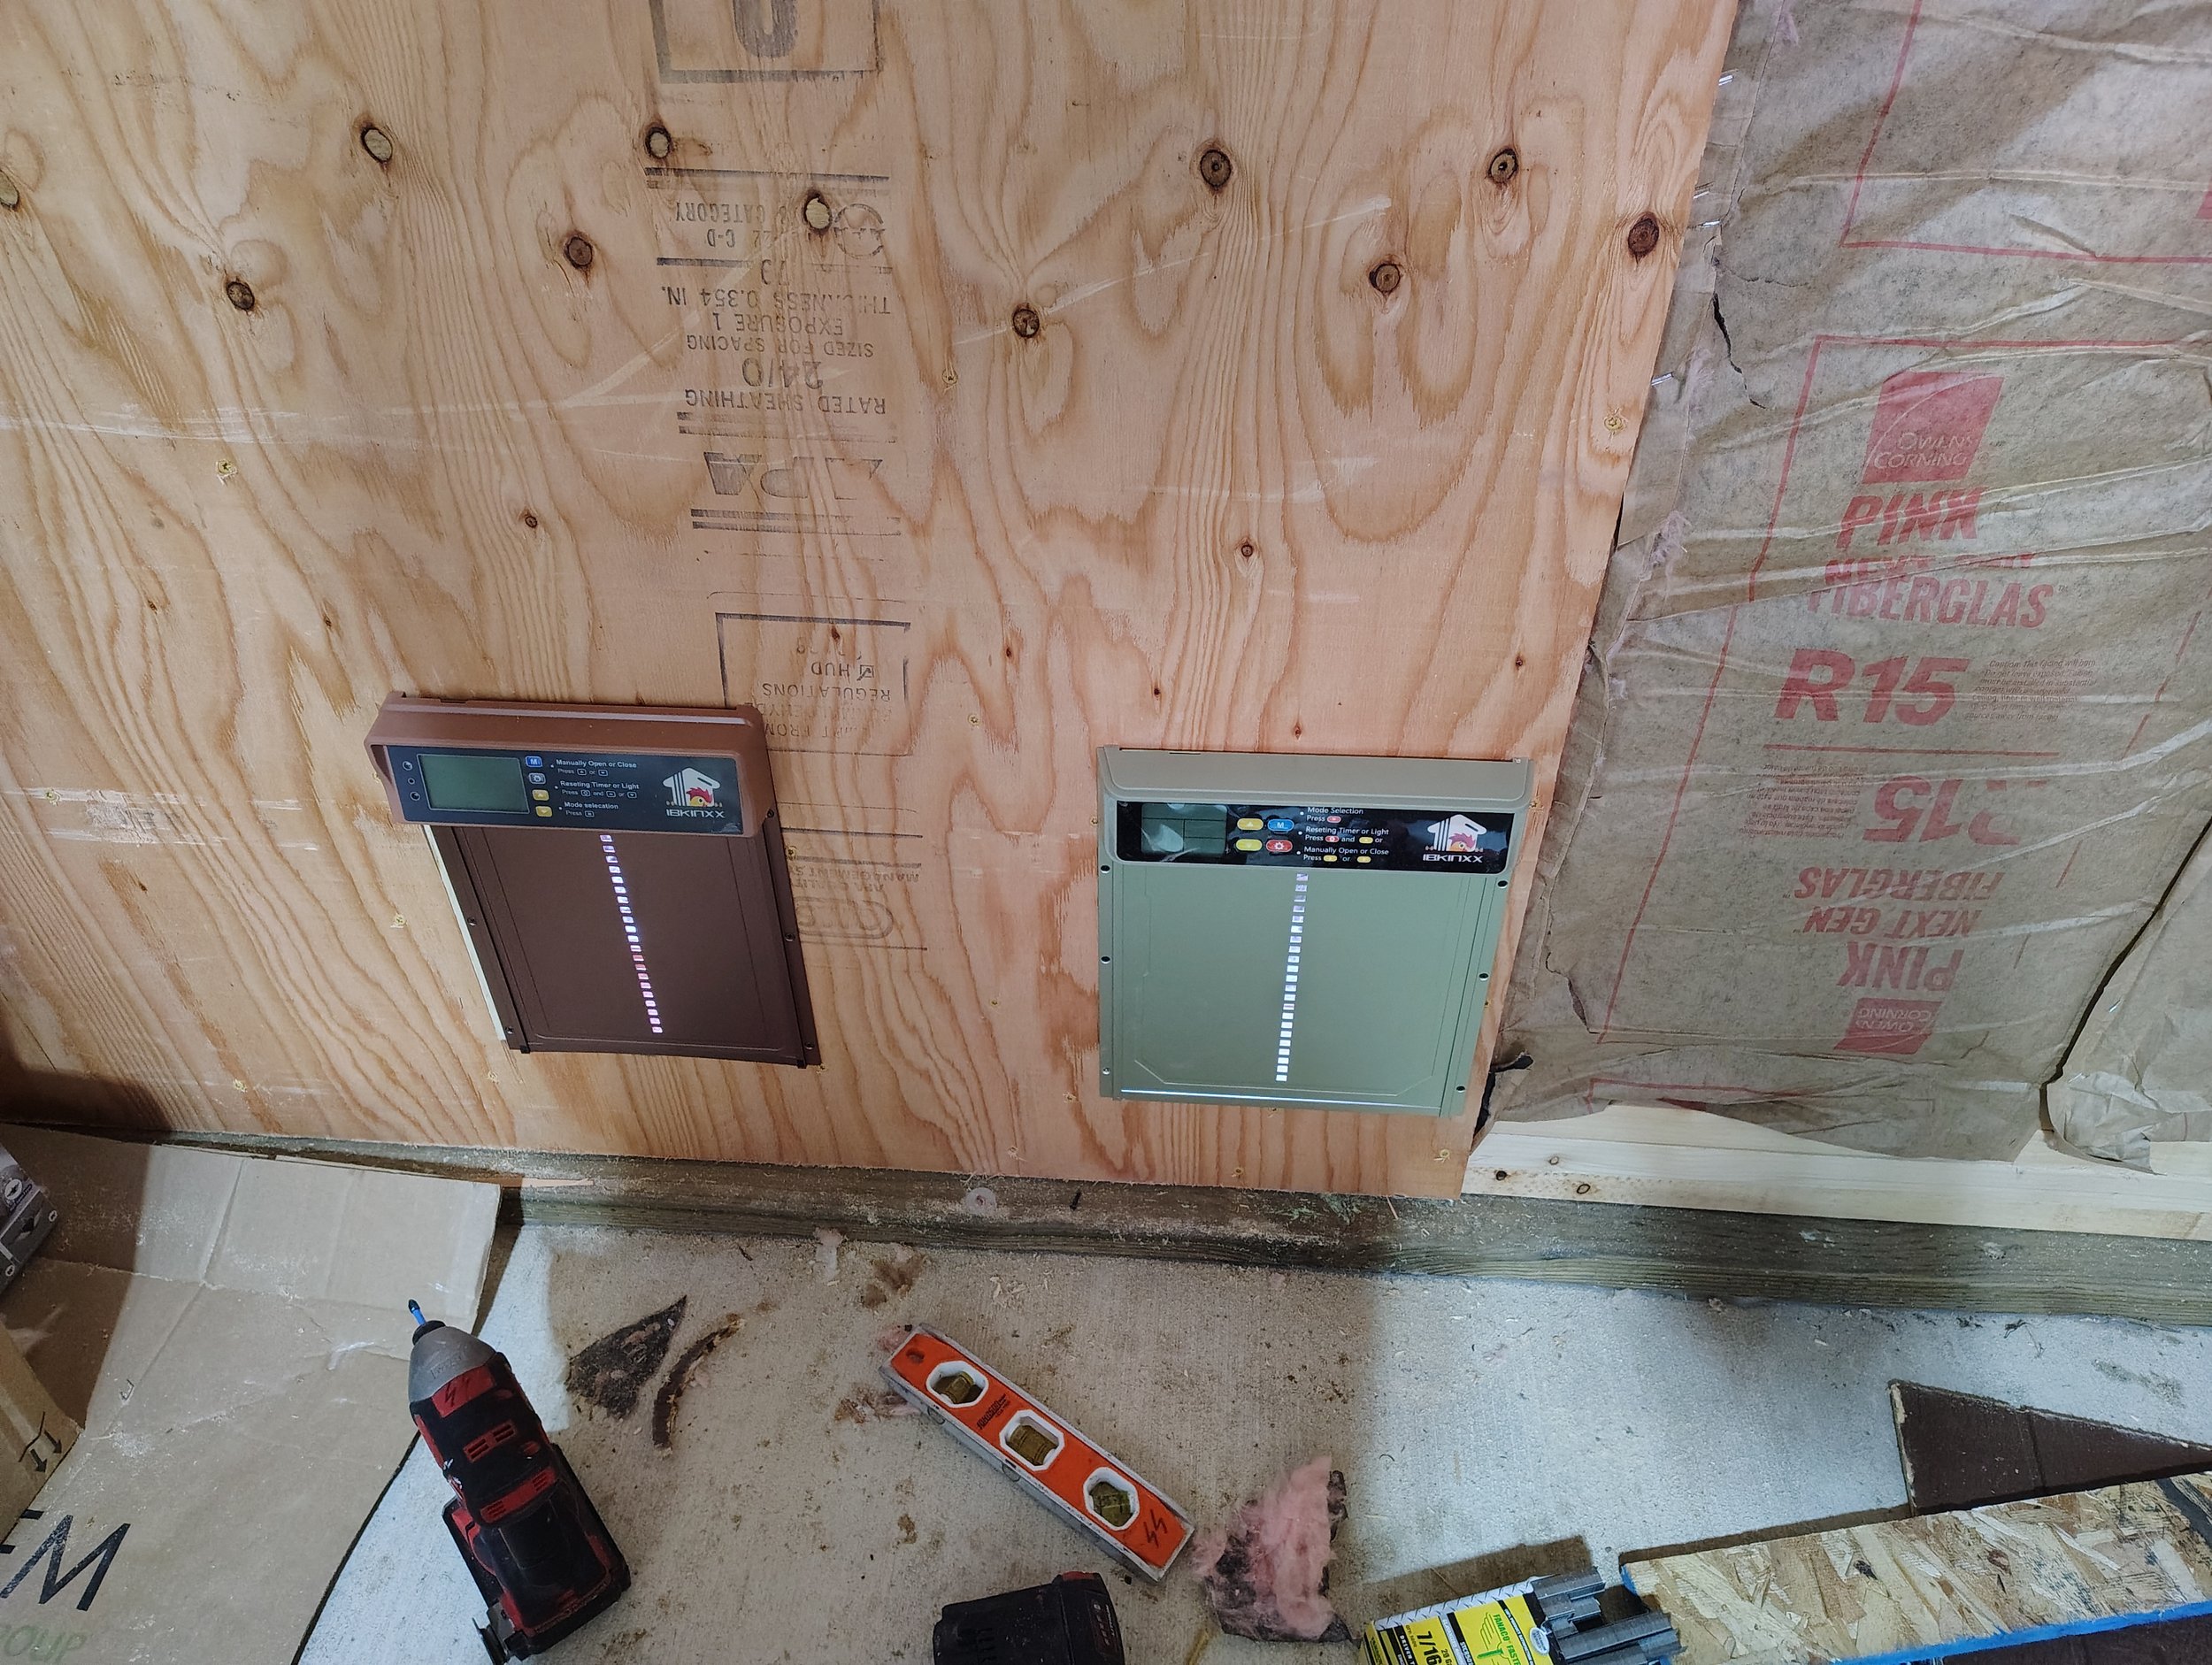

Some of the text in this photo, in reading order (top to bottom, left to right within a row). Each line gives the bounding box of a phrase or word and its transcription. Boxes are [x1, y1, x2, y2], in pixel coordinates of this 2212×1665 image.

[707, 228, 735, 249] C-D
[661, 286, 687, 306] IN.
[700, 288, 758, 308] 0.354
[712, 312, 843, 336] EXPOSURE 1
[687, 334, 874, 357] SIZED FOR SPACING
[741, 357, 824, 390] 24/0
[685, 389, 887, 415] RATED SHEATHING
[1875, 451, 1966, 469] CORNING
[1836, 487, 1987, 549] PINK
[810, 661, 849, 678] HUD
[1774, 648, 1970, 726] R15
[1304, 846, 1337, 855] Manually
[1793, 866, 2006, 902] FIBERGLAS
[1802, 905, 1983, 940] NEXT GEN
[1836, 941, 1964, 991] PINK
[1857, 1007, 1932, 1022] CORNING
[0, 1624, 87, 1664] OUP
[1415, 1630, 1443, 1665] 7/16
